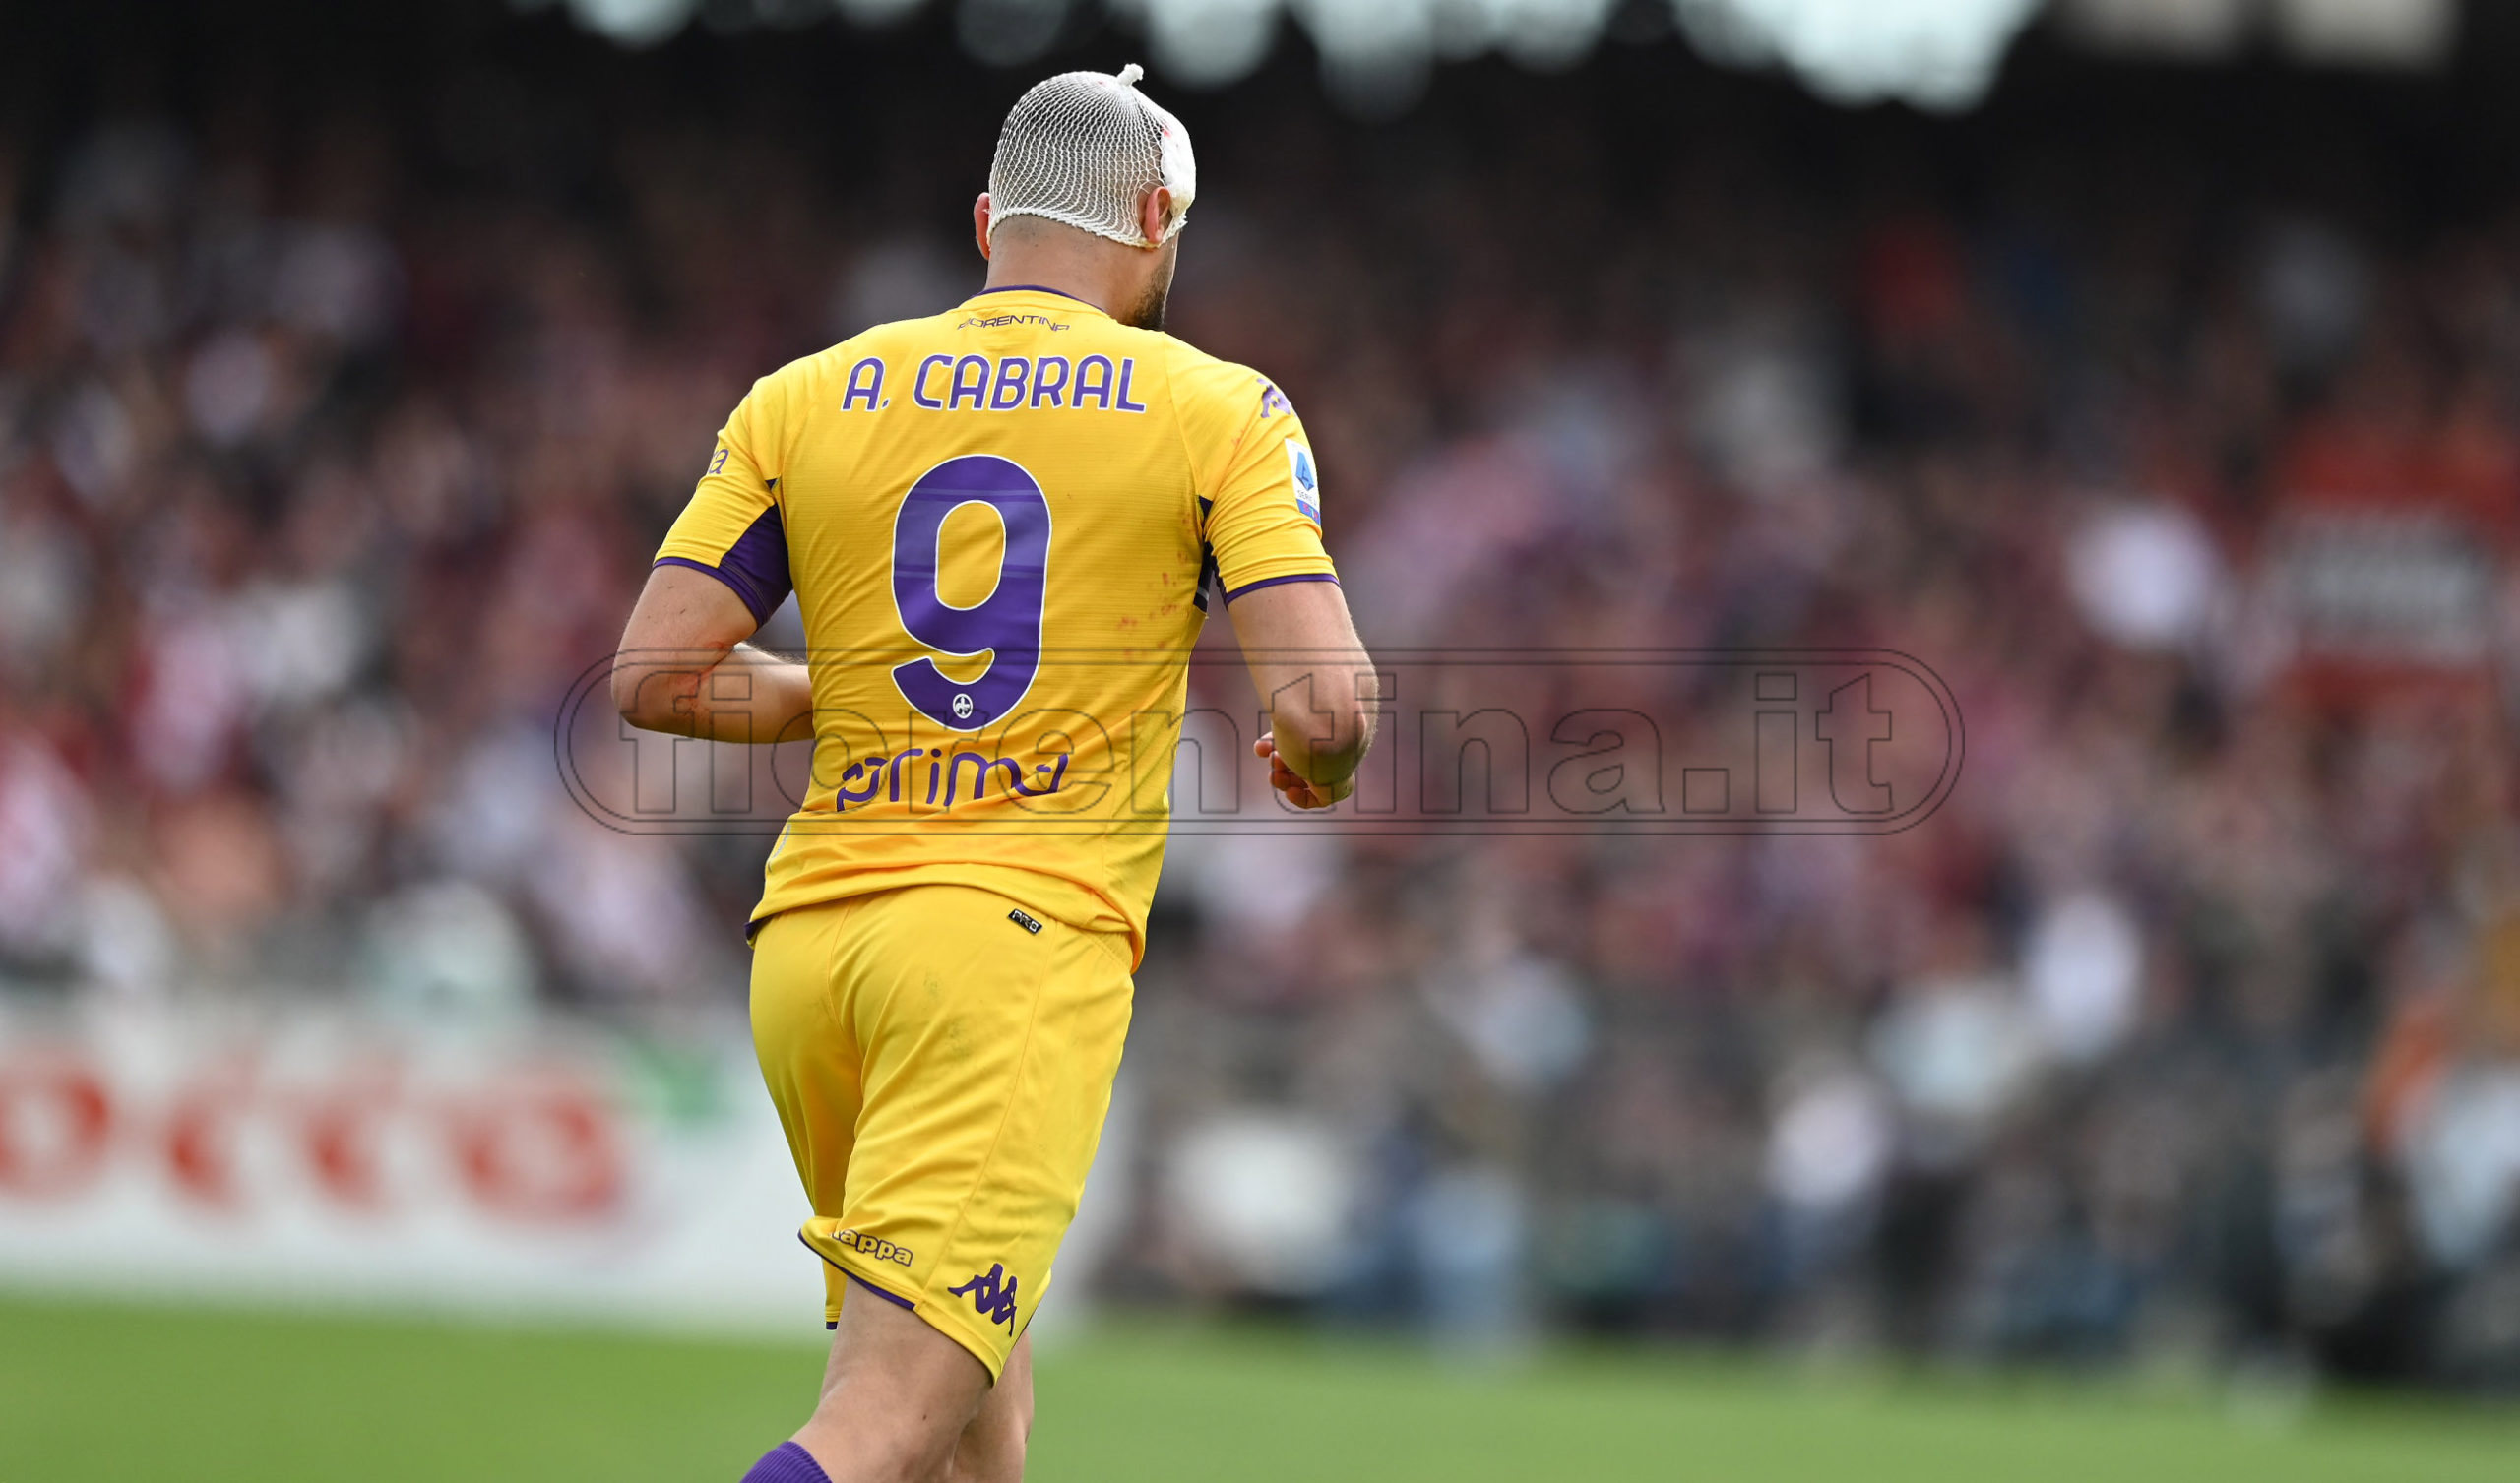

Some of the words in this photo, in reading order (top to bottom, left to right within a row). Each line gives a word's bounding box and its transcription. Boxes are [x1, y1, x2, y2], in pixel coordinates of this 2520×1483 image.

[841, 356, 890, 412] A.
[914, 354, 1147, 414] CABRAL
[892, 454, 1052, 732] 9
[836, 748, 1069, 812] prima
